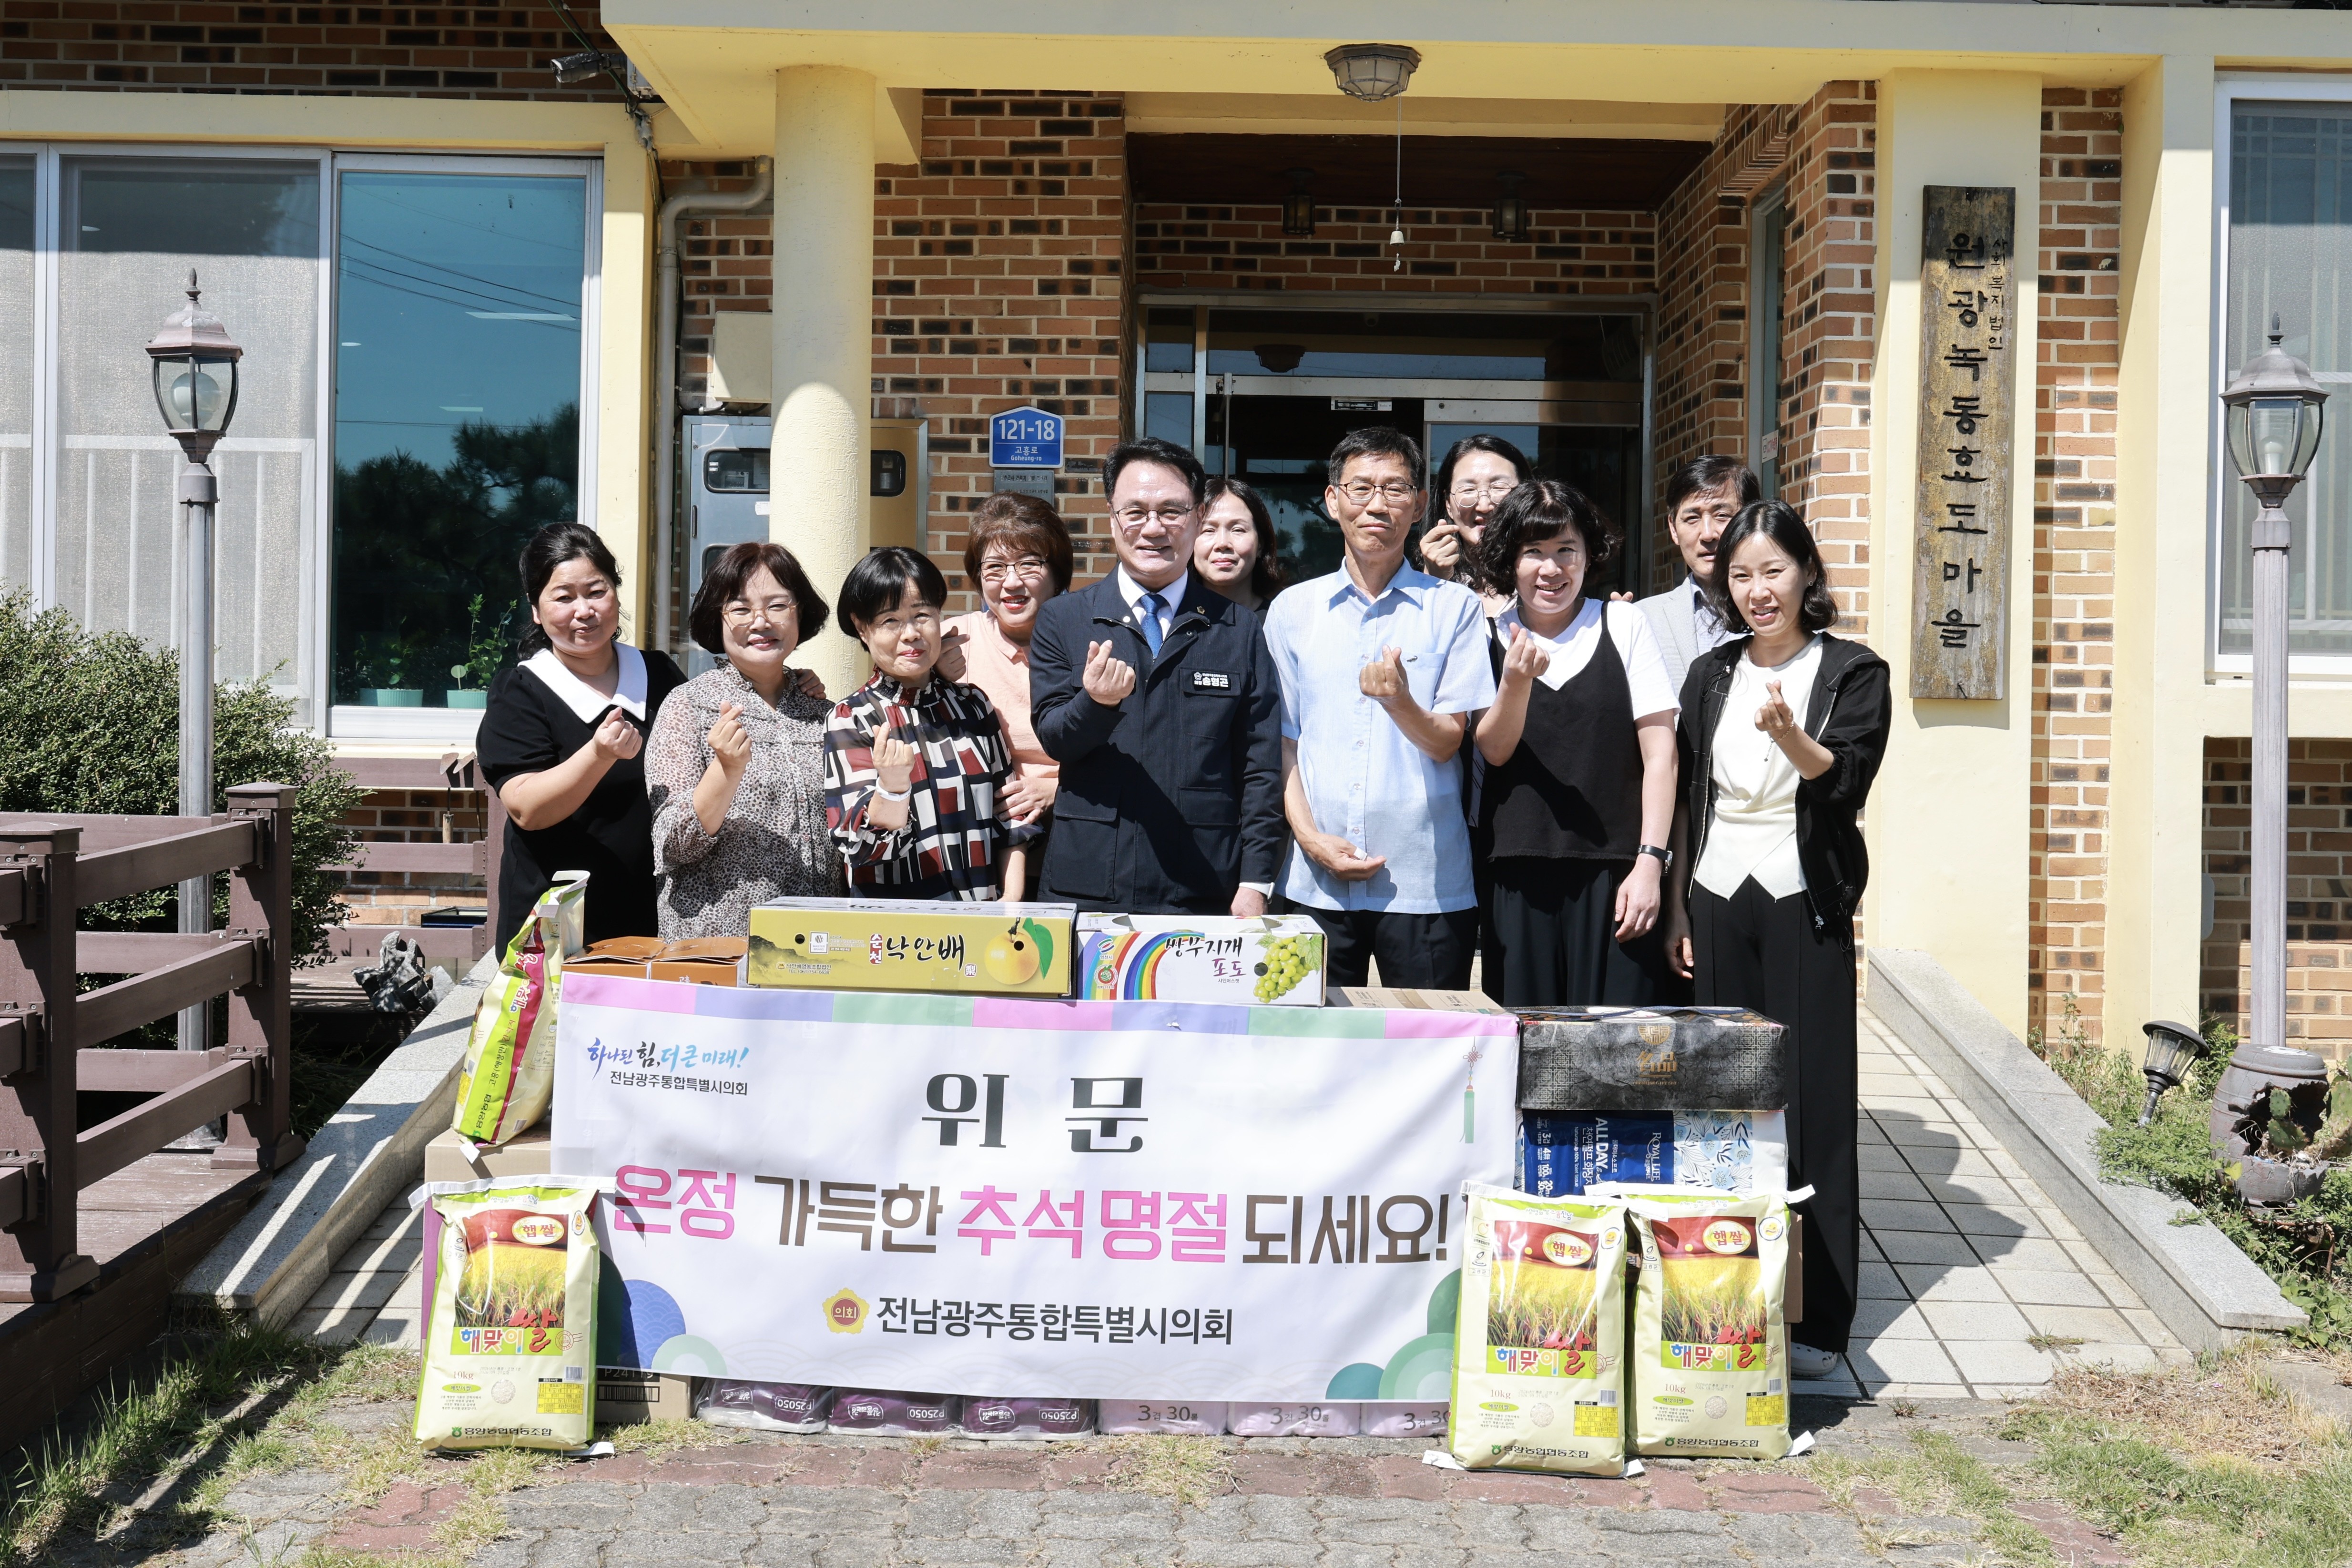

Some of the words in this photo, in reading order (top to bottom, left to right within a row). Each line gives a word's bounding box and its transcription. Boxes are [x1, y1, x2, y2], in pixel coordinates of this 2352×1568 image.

[998, 419, 1055, 440] 121-18
[1015, 446, 1038, 456] 고흥로
[1202, 677, 1228, 687] 송형곤
[870, 934, 883, 963] 순천
[886, 935, 964, 970] 낙안배
[1166, 937, 1243, 958] 쌍무지개
[1212, 958, 1247, 977] 포도
[587, 1037, 633, 1080] 하나된
[681, 1044, 698, 1068] 큰
[702, 1047, 750, 1069] 미래!
[1637, 1050, 1677, 1072] 名品
[610, 1071, 748, 1096] 전남광주통합특별시의회
[1595, 1117, 1608, 1141] ALL
[1542, 1133, 1551, 1144] 3겹
[1582, 1127, 1593, 1161] 천연펄프
[1650, 1132, 1661, 1162] ROYAL
[1596, 1142, 1609, 1169] DAY
[1652, 1163, 1661, 1181] LIFE
[613, 1164, 736, 1240] 온정
[754, 1175, 943, 1254] 가득한
[957, 1184, 1084, 1259] 추석
[1099, 1189, 1227, 1263] 명절
[1242, 1193, 1448, 1264] 되세요!
[522, 1223, 556, 1238] 햅쌀
[1712, 1230, 1743, 1246] 햅쌀
[1552, 1241, 1584, 1259] 햅쌀
[834, 1306, 856, 1319] 의회
[876, 1296, 1232, 1344] 전남광주통합특별시의회
[453, 1371, 474, 1380] 10kg
[1490, 1389, 1511, 1399] 10kg
[1664, 1383, 1686, 1394] 10kg
[777, 1399, 812, 1411] P25050
[909, 1408, 945, 1419] P25050
[1138, 1405, 1161, 1421] 3겹
[1041, 1410, 1077, 1420] P25050
[464, 1427, 553, 1436] 흥양농업협동조합
[1677, 1438, 1759, 1447] 흥양농업협동조합
[1504, 1445, 1589, 1458] 흥양농업협동조합
